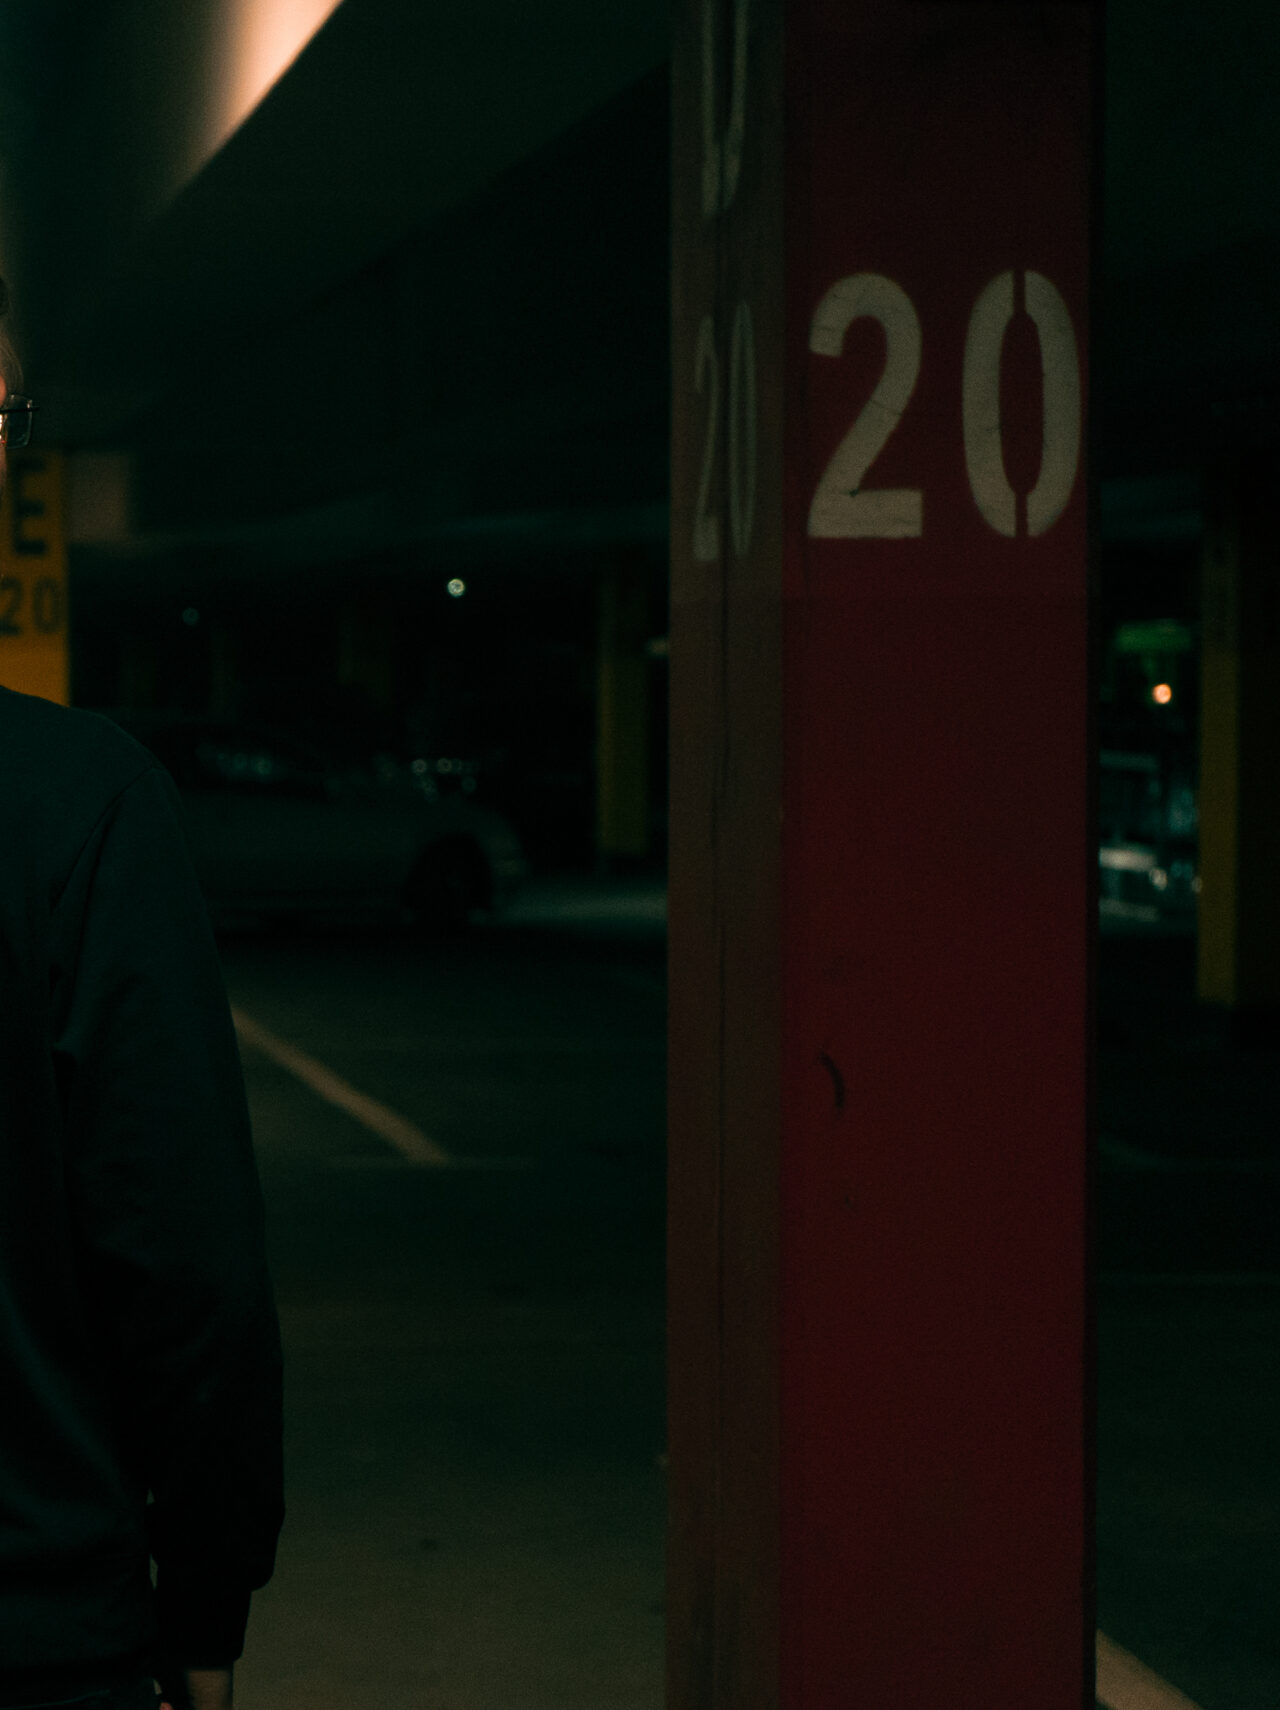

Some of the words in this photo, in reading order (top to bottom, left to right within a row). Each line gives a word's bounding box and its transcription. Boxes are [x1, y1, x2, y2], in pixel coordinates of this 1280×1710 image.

[13, 455, 46, 554] E
[692, 299, 757, 563] 20
[806, 268, 1082, 539] 20
